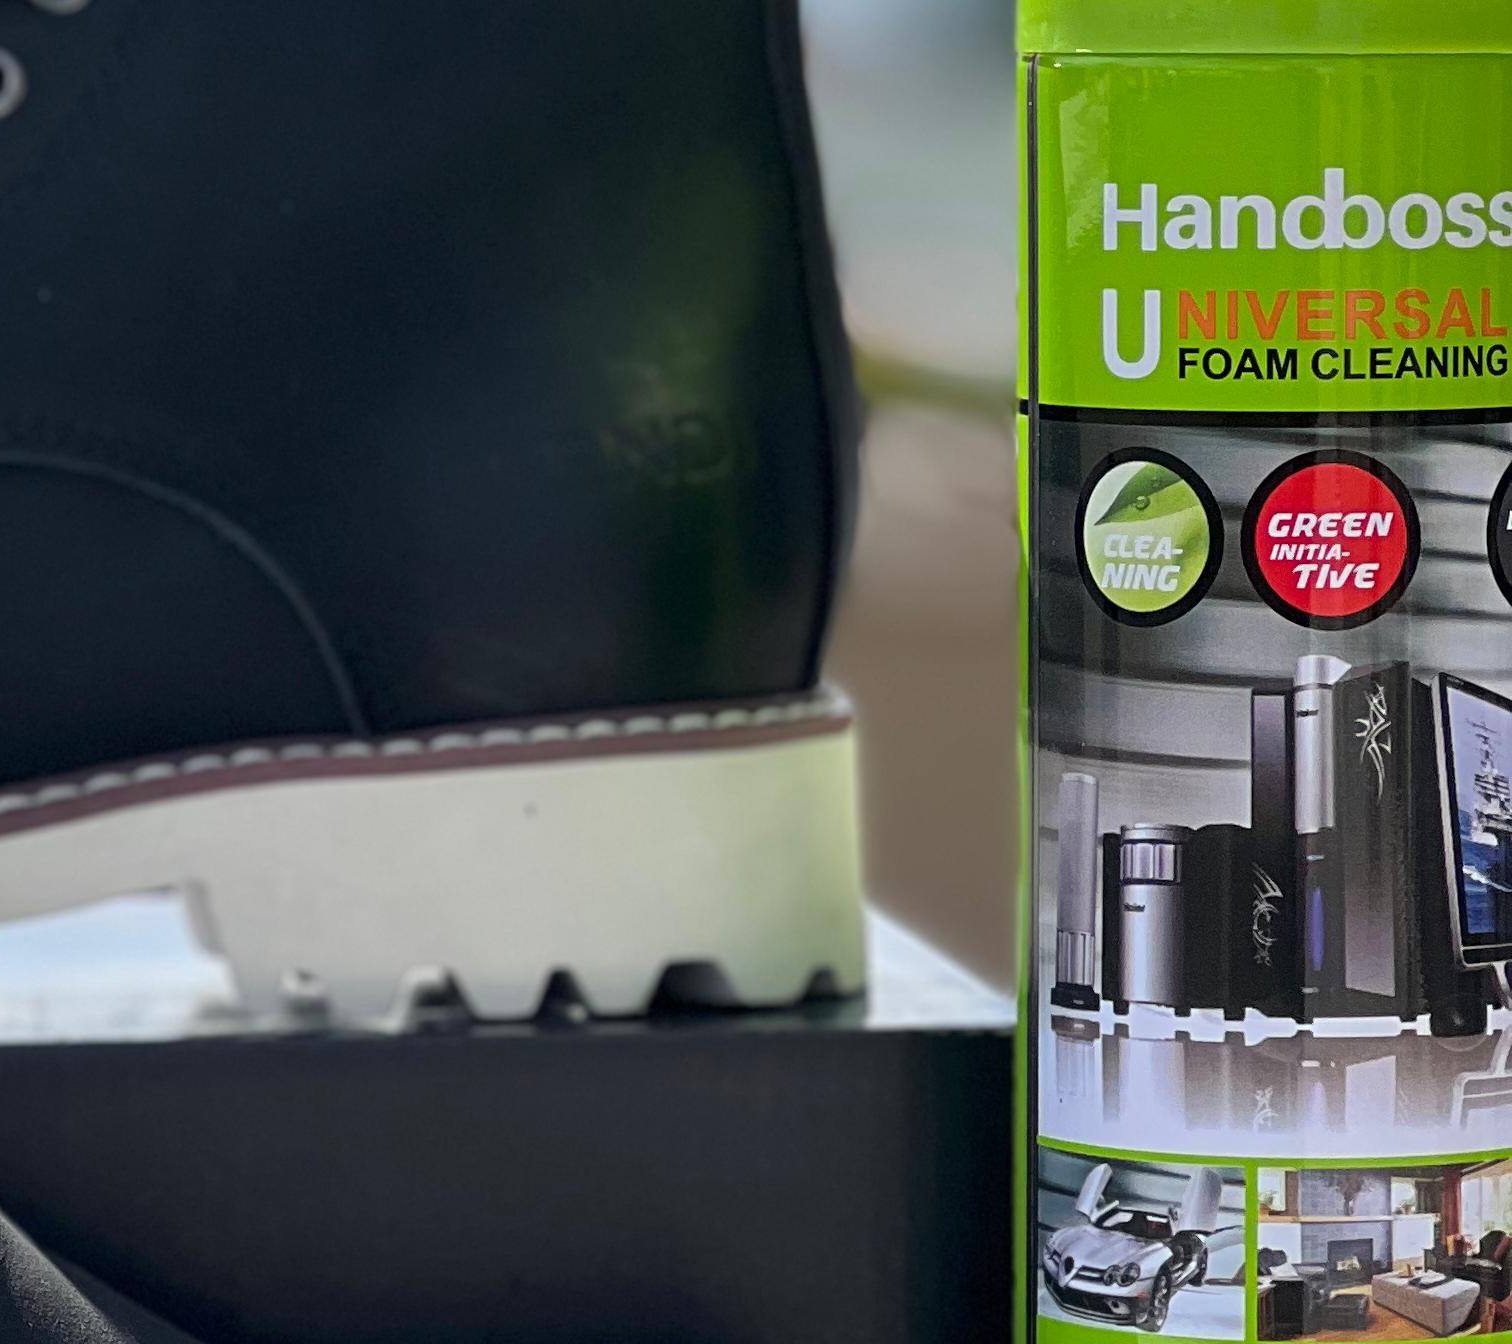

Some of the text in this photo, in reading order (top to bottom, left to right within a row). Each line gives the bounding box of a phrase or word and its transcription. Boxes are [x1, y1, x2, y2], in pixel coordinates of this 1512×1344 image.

[1102, 167, 1512, 252] Handboss
[1178, 344, 1509, 381] FOAM CLEANING
[1267, 511, 1394, 538] GREEN
[1103, 533, 1184, 560] CLEA-
[1270, 543, 1351, 561] INITIA-
[1101, 562, 1180, 592] NING
[1292, 562, 1380, 590] TIVE
